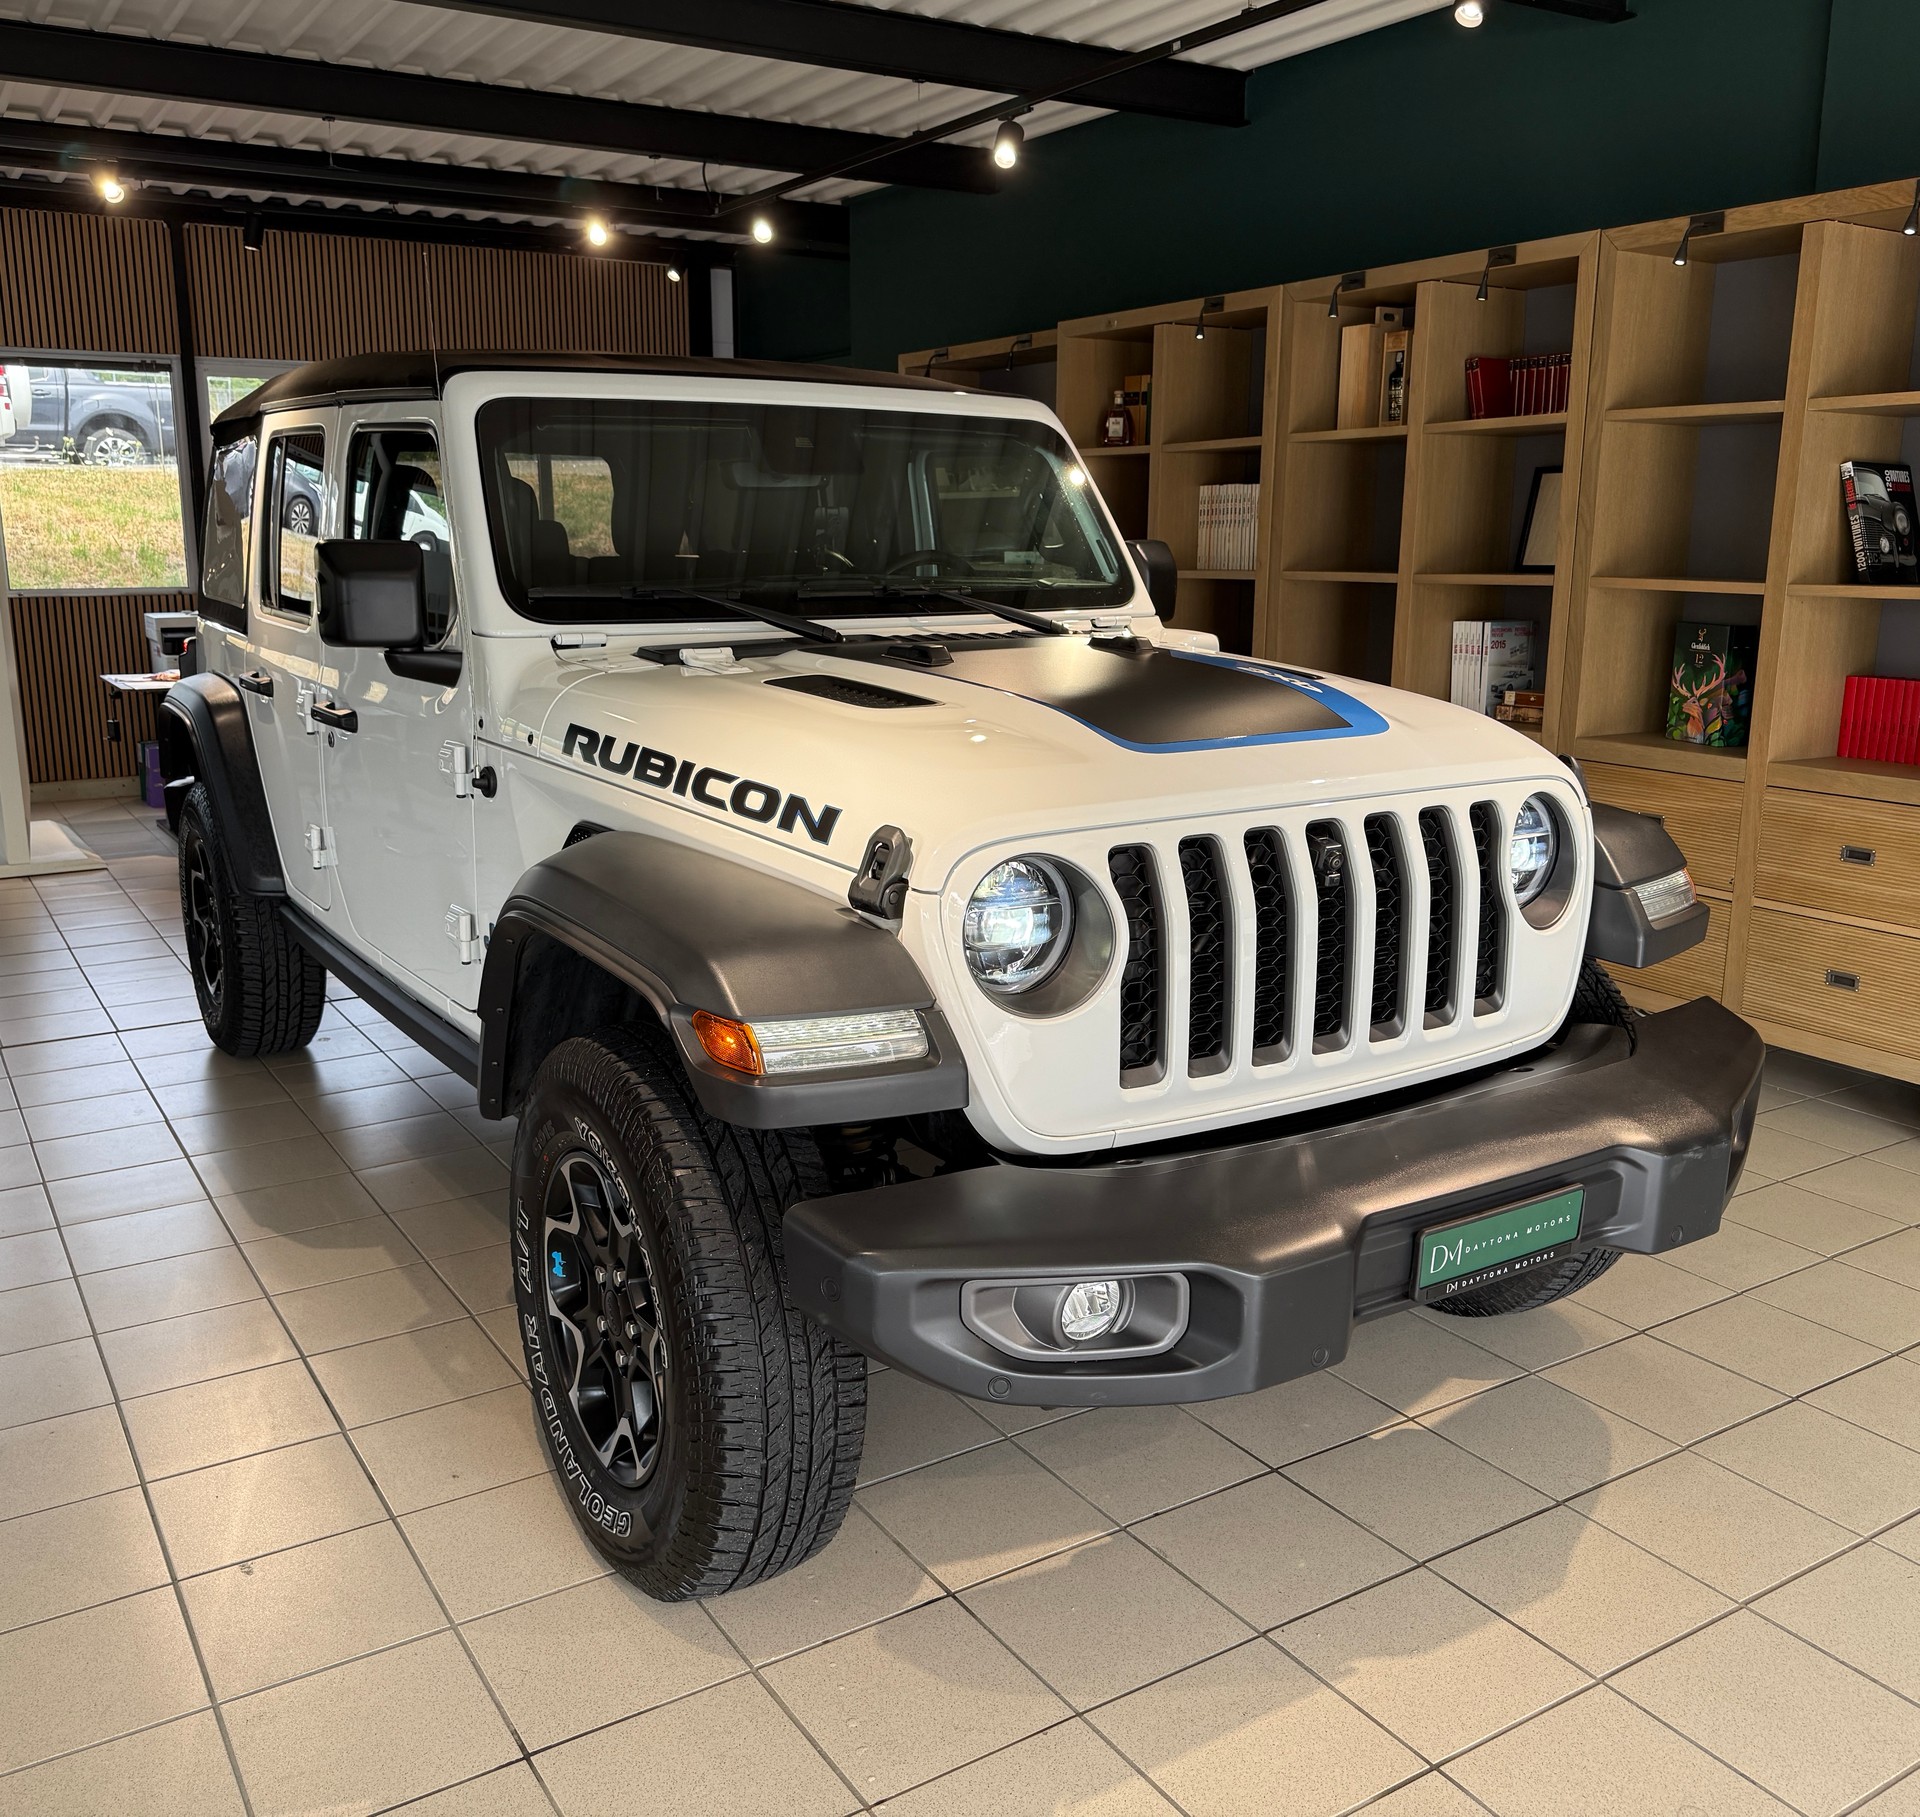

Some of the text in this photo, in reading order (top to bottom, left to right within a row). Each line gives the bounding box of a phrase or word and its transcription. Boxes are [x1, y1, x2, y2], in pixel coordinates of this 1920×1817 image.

[1850, 515, 1864, 552] VOITURES
[1856, 551, 1867, 572] 1200
[1491, 640, 1506, 649] 2015
[1695, 653, 1704, 664] 12
[562, 723, 843, 846] RUBICON
[516, 1197, 531, 1294] A/T
[1465, 1232, 1518, 1254] DAYTONA
[1526, 1215, 1571, 1234] MOTORS
[1462, 1267, 1508, 1287] DAYTONA
[1515, 1251, 1555, 1270] MOTORS
[524, 1313, 632, 1538] GEOLANDAR
